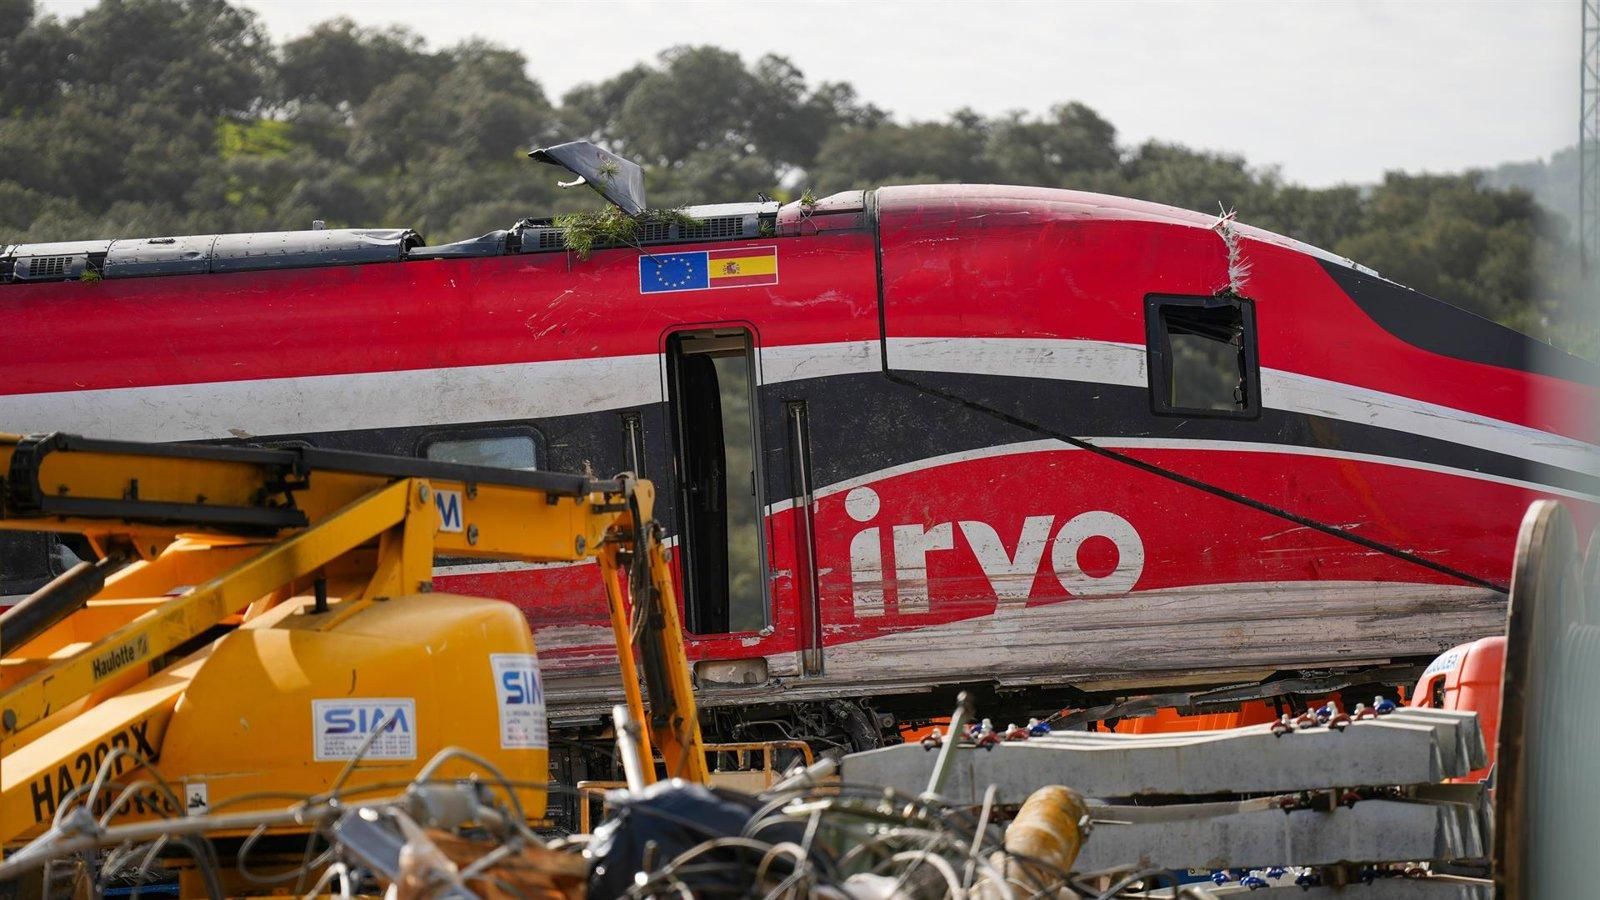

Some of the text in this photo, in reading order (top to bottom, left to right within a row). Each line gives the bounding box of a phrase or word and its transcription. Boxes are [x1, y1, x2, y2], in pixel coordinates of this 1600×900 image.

[92, 644, 135, 680] Haulotte
[324, 707, 409, 734] SIM
[30, 719, 159, 823] HA20PX
